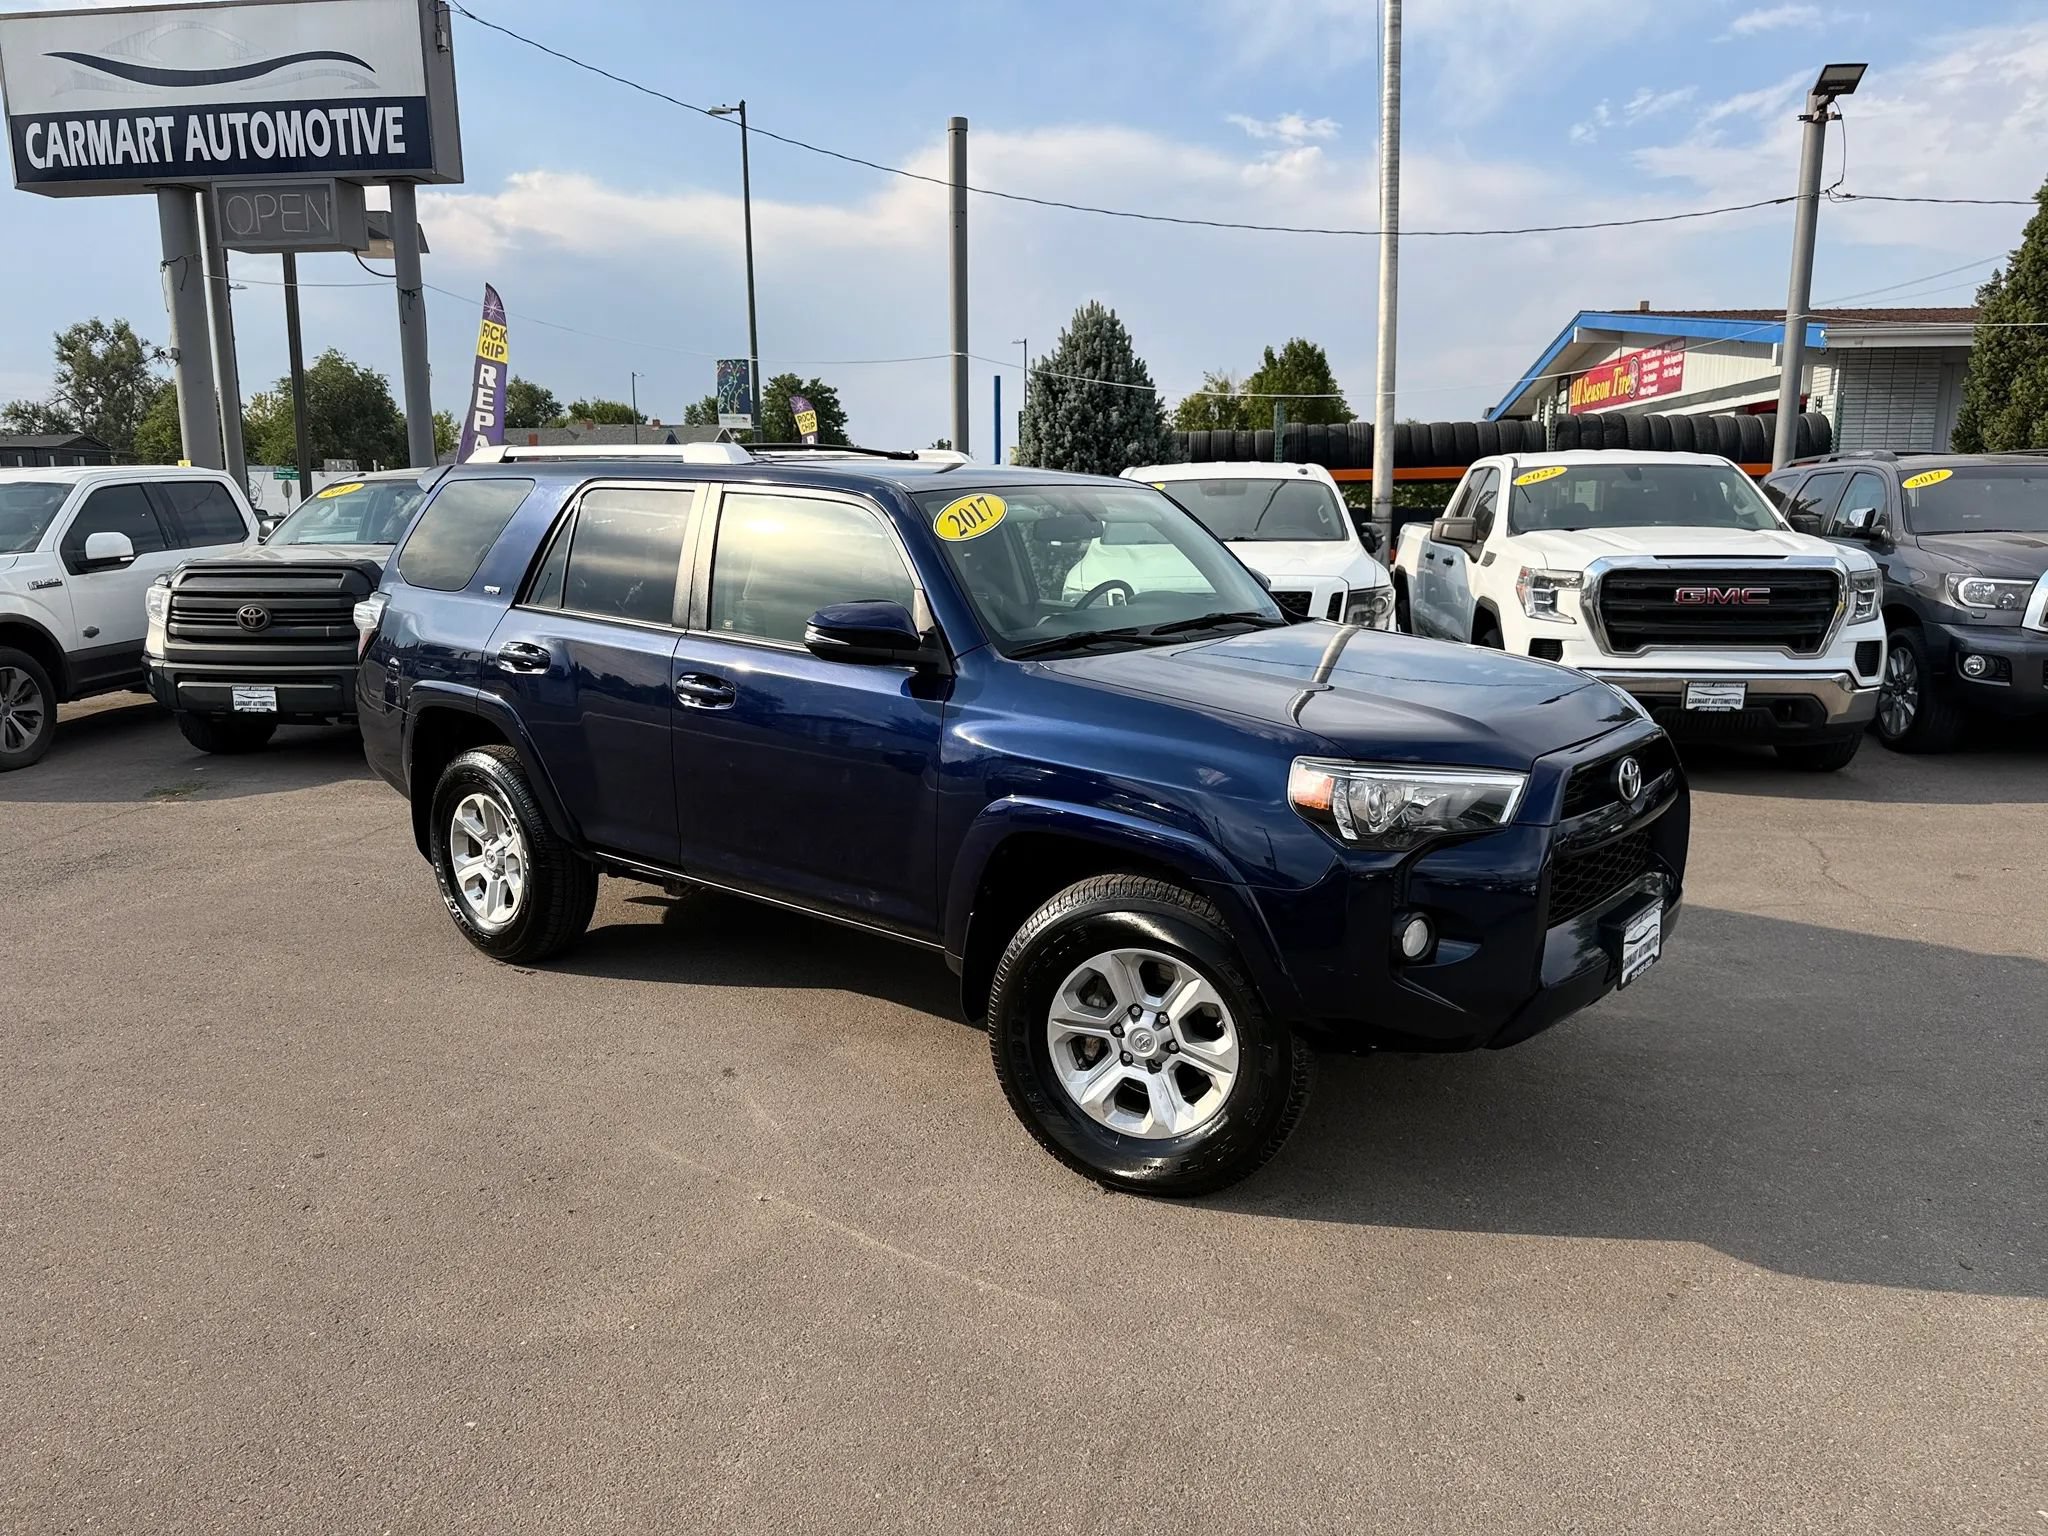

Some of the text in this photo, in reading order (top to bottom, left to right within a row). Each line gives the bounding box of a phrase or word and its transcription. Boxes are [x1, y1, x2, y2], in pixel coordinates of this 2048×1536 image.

[26, 107, 406, 169] CARMART AUTOMOTIVE
[226, 192, 330, 235] OPEN
[1571, 377, 1583, 406] All
[1582, 377, 1611, 404] Season
[796, 412, 816, 423] ROCK
[801, 421, 816, 433] CHIP
[1525, 468, 1556, 482] 2022
[1912, 471, 1941, 486] 2017
[947, 496, 993, 537] 2017
[1674, 587, 1771, 605] GMC
[1688, 697, 1743, 706] CARMART AUTOMOTIVE
